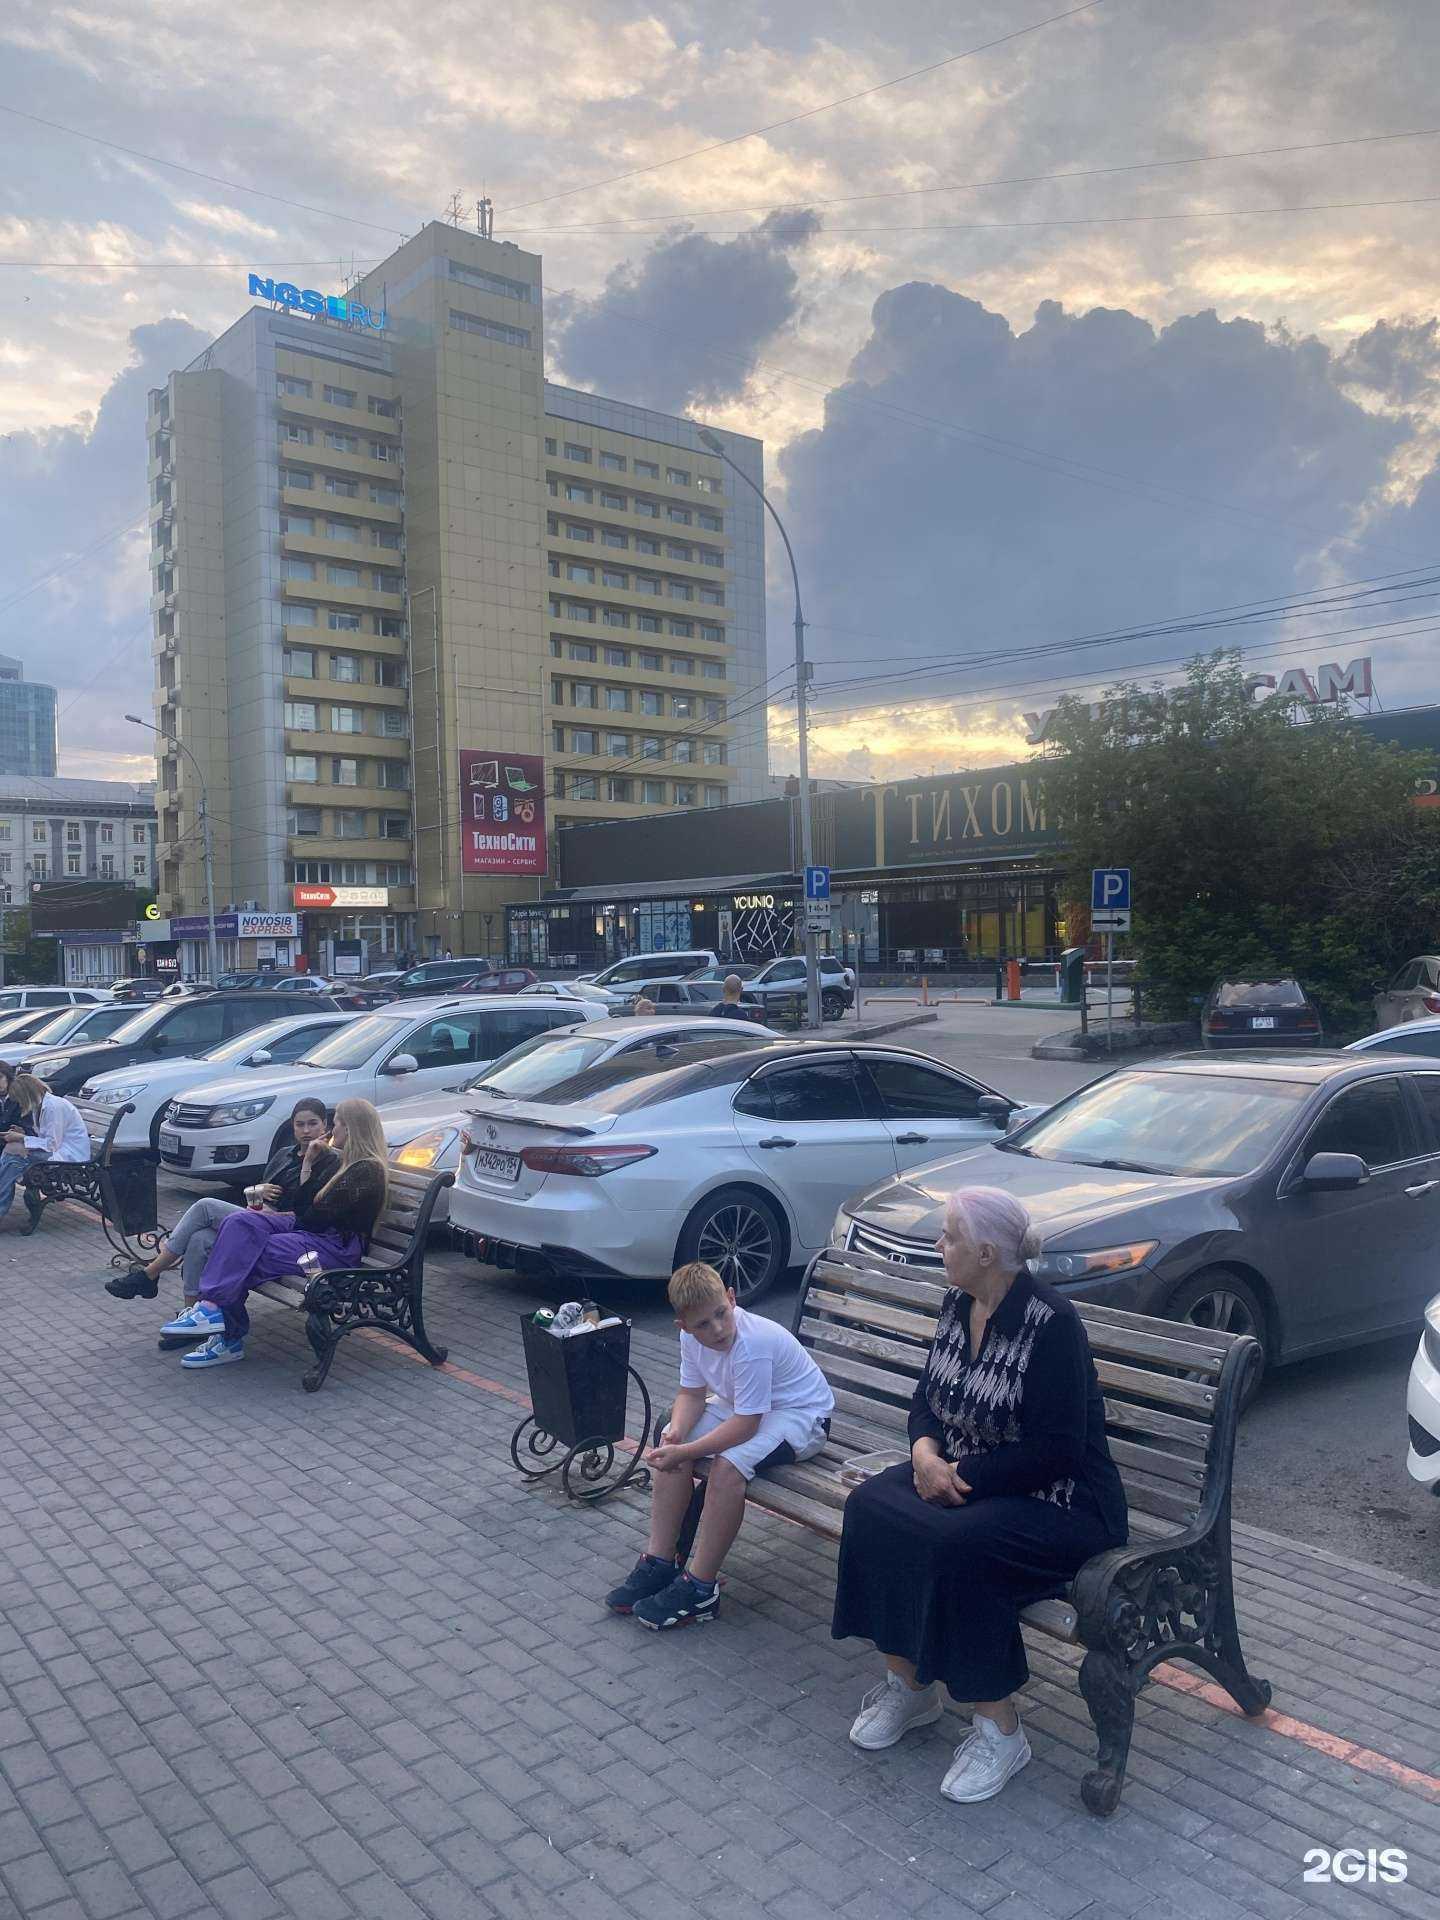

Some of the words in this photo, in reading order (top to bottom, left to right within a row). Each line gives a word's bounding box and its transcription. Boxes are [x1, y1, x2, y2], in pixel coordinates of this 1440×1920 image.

[472, 831, 536, 851] ТехноСити
[474, 857, 505, 865] МАГАЗИН
[812, 870, 826, 896] P
[1103, 874, 1123, 905] P
[242, 916, 292, 926] NOVOSIB
[242, 925, 293, 935] EXPRESS
